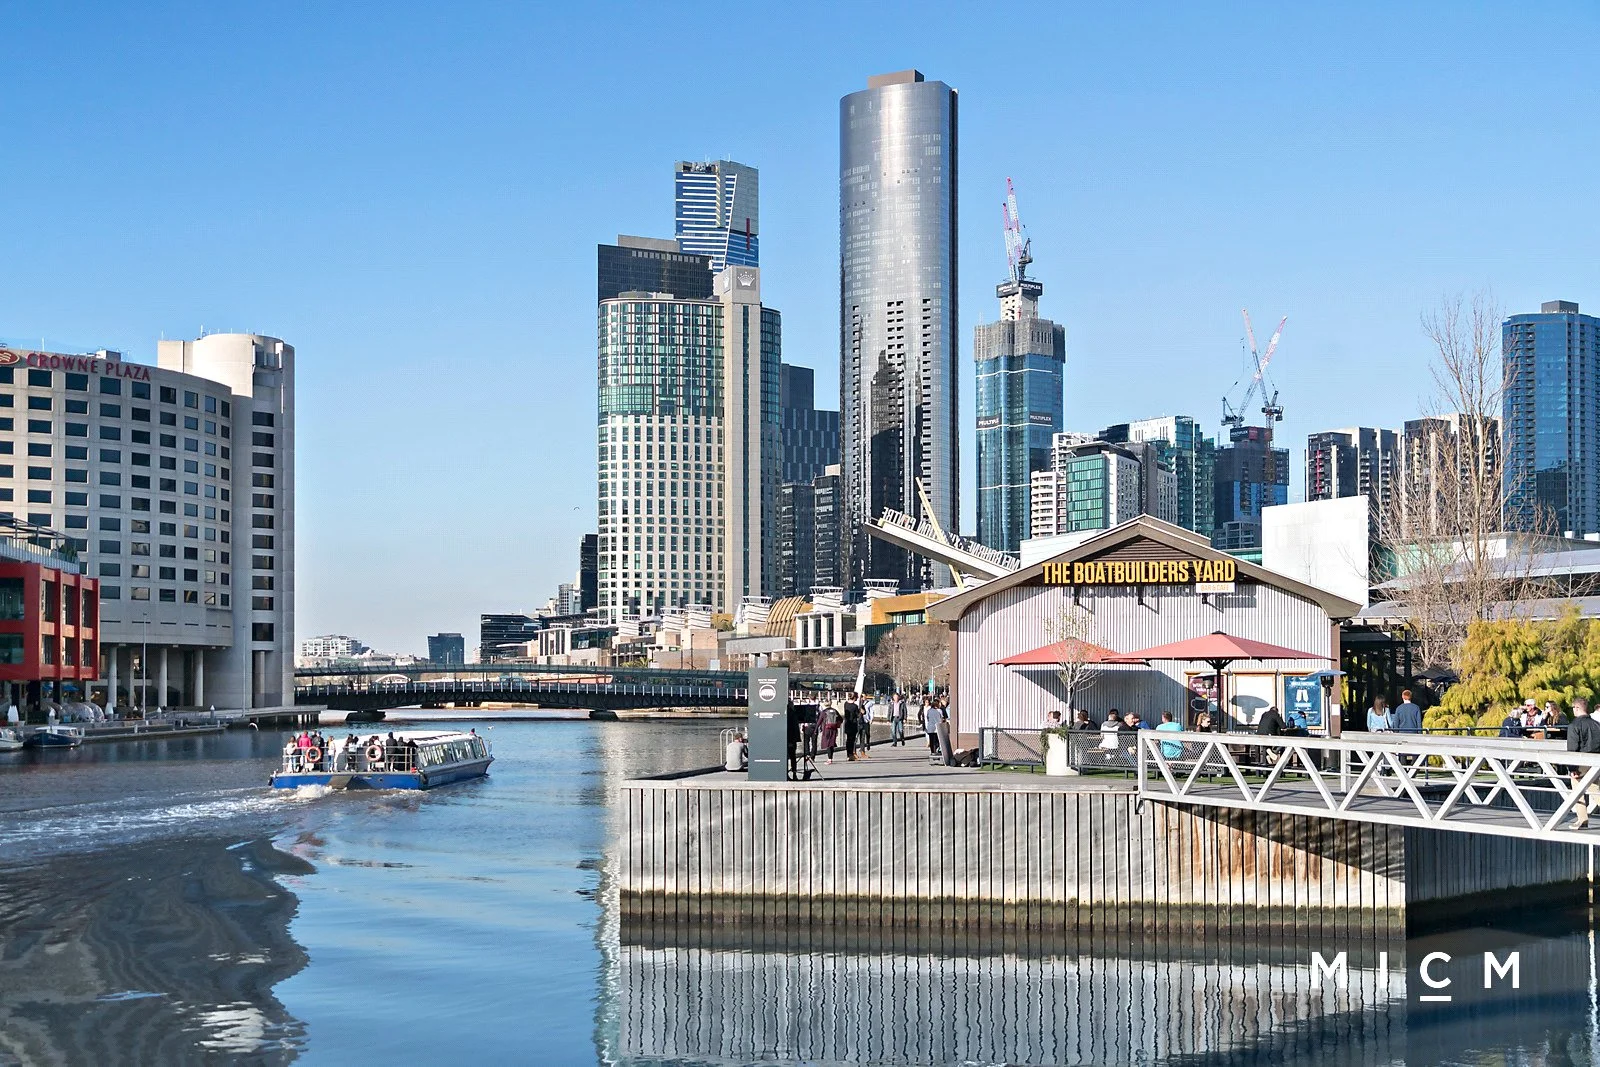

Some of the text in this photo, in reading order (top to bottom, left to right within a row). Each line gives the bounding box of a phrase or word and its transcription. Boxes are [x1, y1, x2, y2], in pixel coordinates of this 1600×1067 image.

[26, 352, 151, 382] CROWNE PLAZA
[1042, 559, 1235, 584] THE BOATBUILDERS YARD
